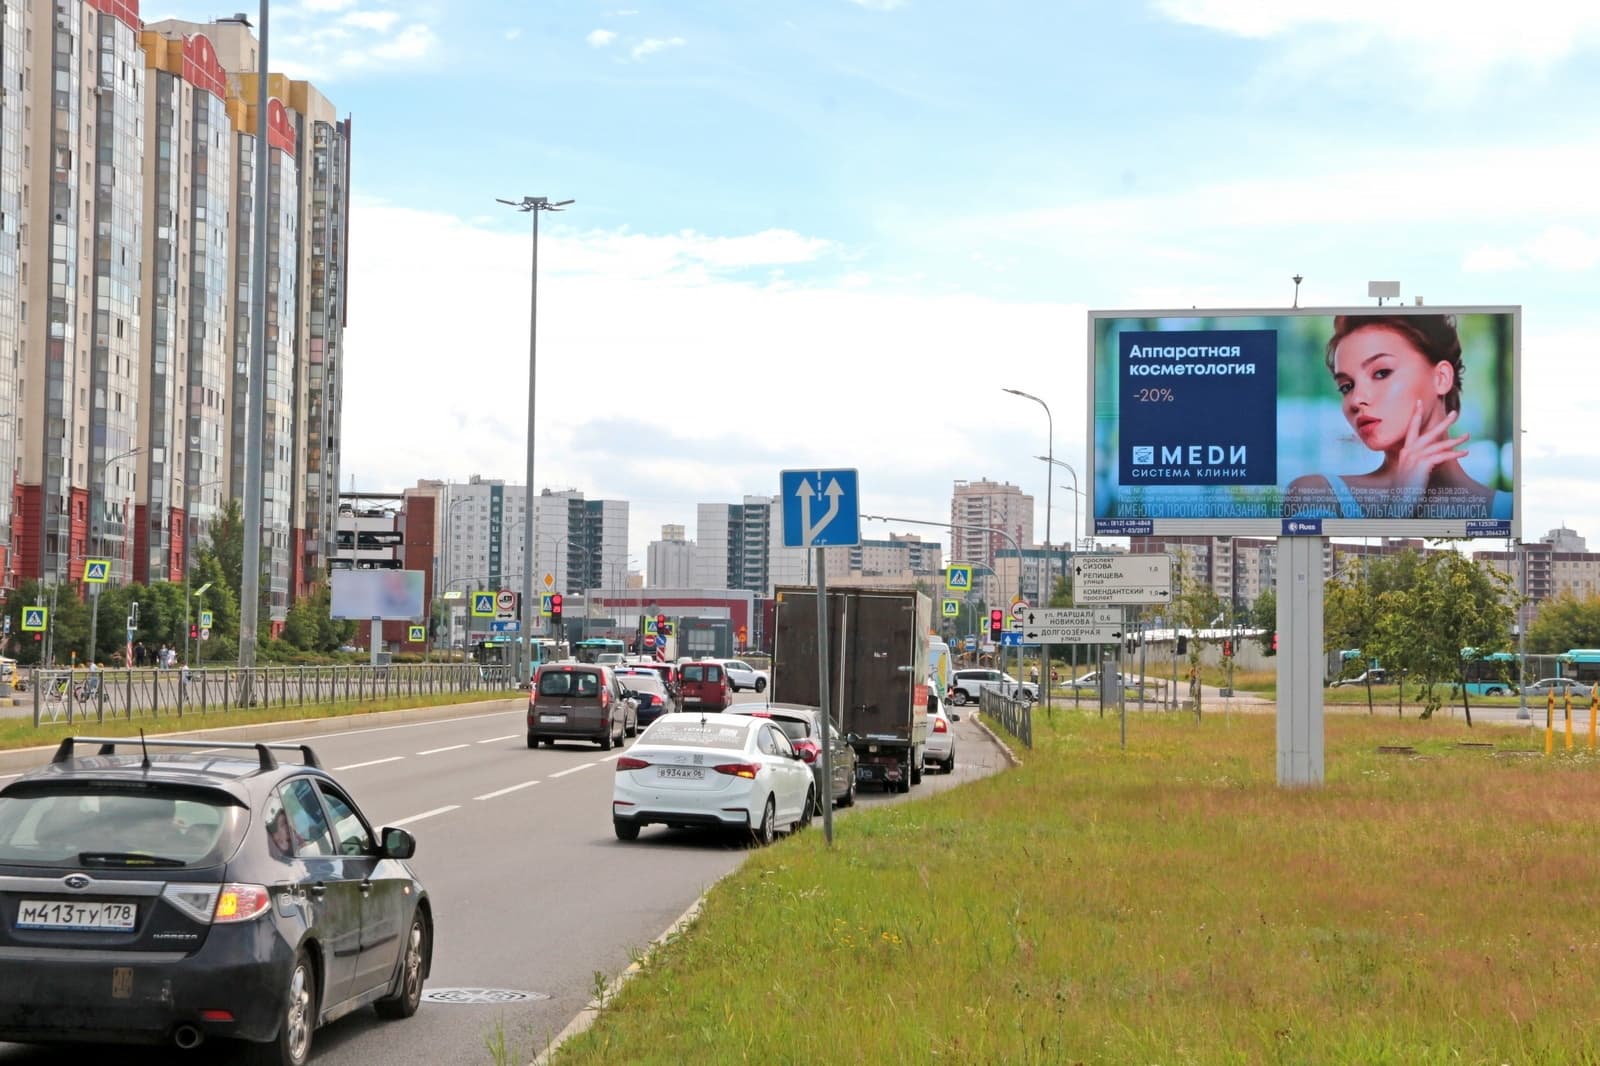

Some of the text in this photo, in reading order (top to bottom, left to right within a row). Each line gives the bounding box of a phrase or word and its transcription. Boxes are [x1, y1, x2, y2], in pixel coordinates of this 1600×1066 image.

[1129, 345, 1240, 360] Аппаратная
[1129, 363, 1256, 376] косметология
[1133, 388, 1175, 402] -20%
[1132, 469, 1247, 478] СИСТЕМА КЛИНИК
[1117, 503, 1165, 517] ИМЕЮТСЯ
[1271, 503, 1337, 518] НЕОБХОДИМА
[1340, 503, 1414, 518] КОНСУЛЬТАЦИЯ
[1416, 503, 1488, 518] СПЕЦИАЛИСТА
[1298, 523, 1317, 531] Russ
